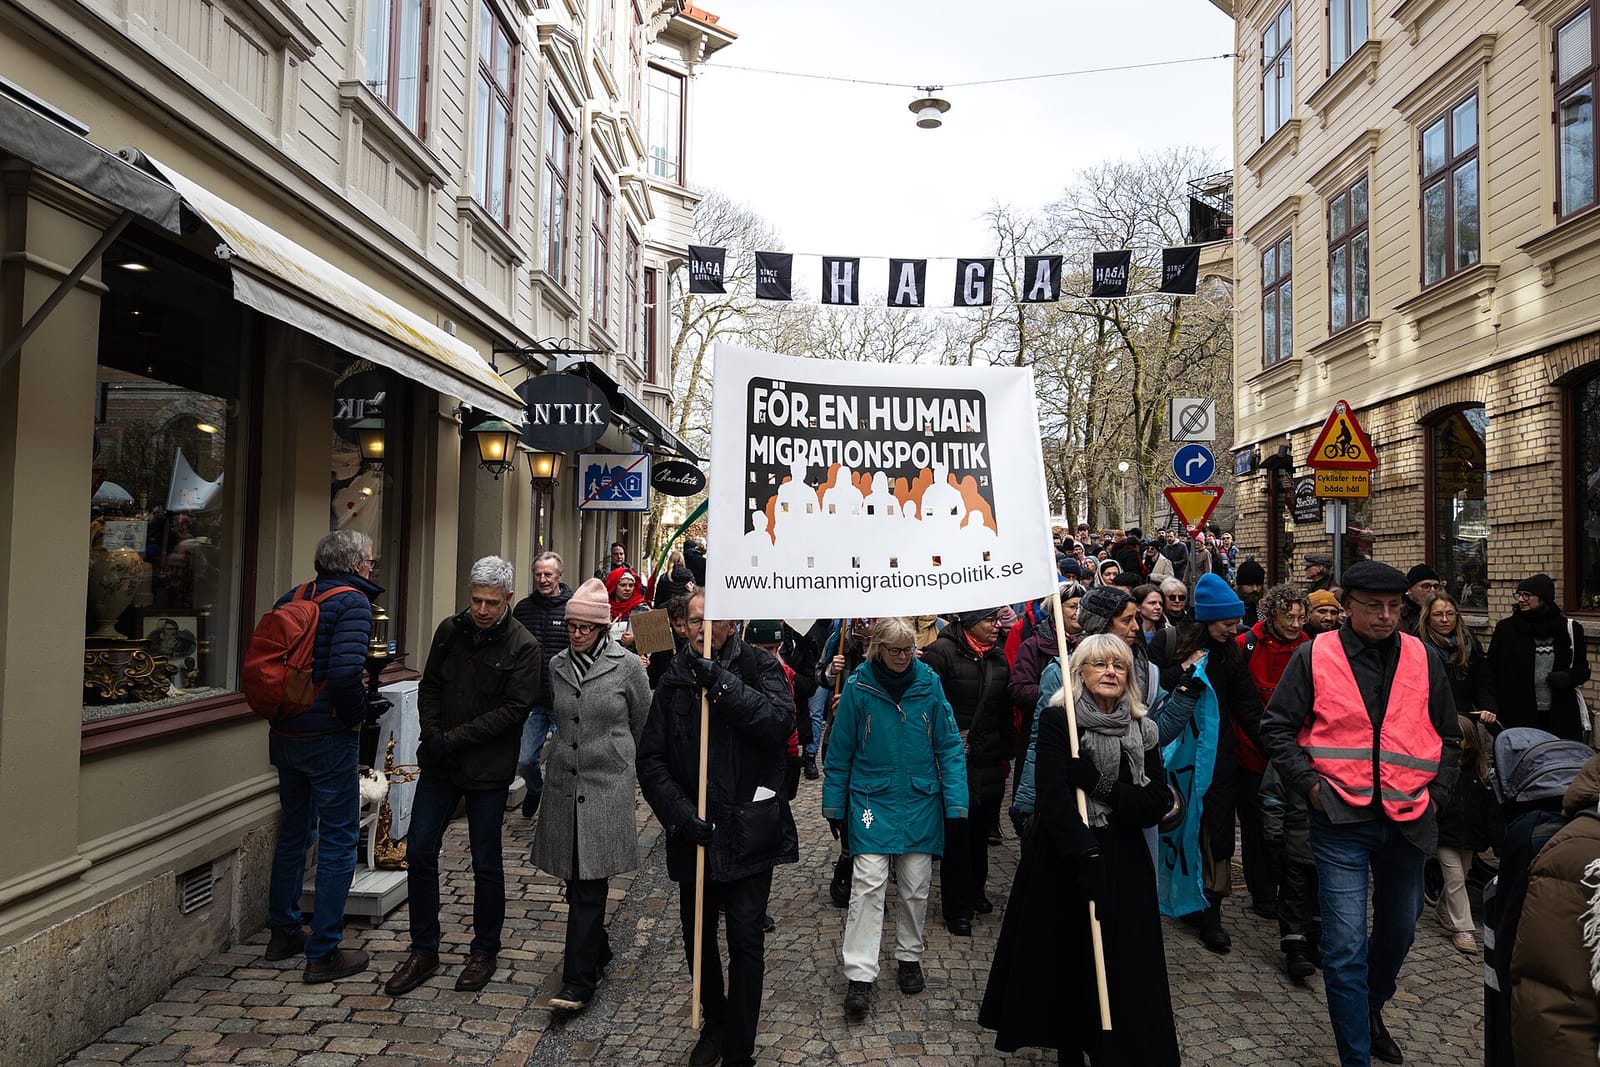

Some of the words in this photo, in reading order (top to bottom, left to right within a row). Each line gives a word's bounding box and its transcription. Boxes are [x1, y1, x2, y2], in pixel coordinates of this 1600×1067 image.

[691, 260, 720, 276] HAGA
[1096, 265, 1125, 282] HAGA
[753, 381, 809, 428] FÖR
[819, 394, 858, 431] EN
[869, 396, 981, 433] HUMAN
[750, 434, 987, 469] MIGRATIONSPOLITIK
[1317, 474, 1349, 482] Cyklister
[1351, 474, 1367, 482] från
[1346, 485, 1360, 493] håll
[725, 559, 1024, 593] www.humanmigrationspolitik.se
